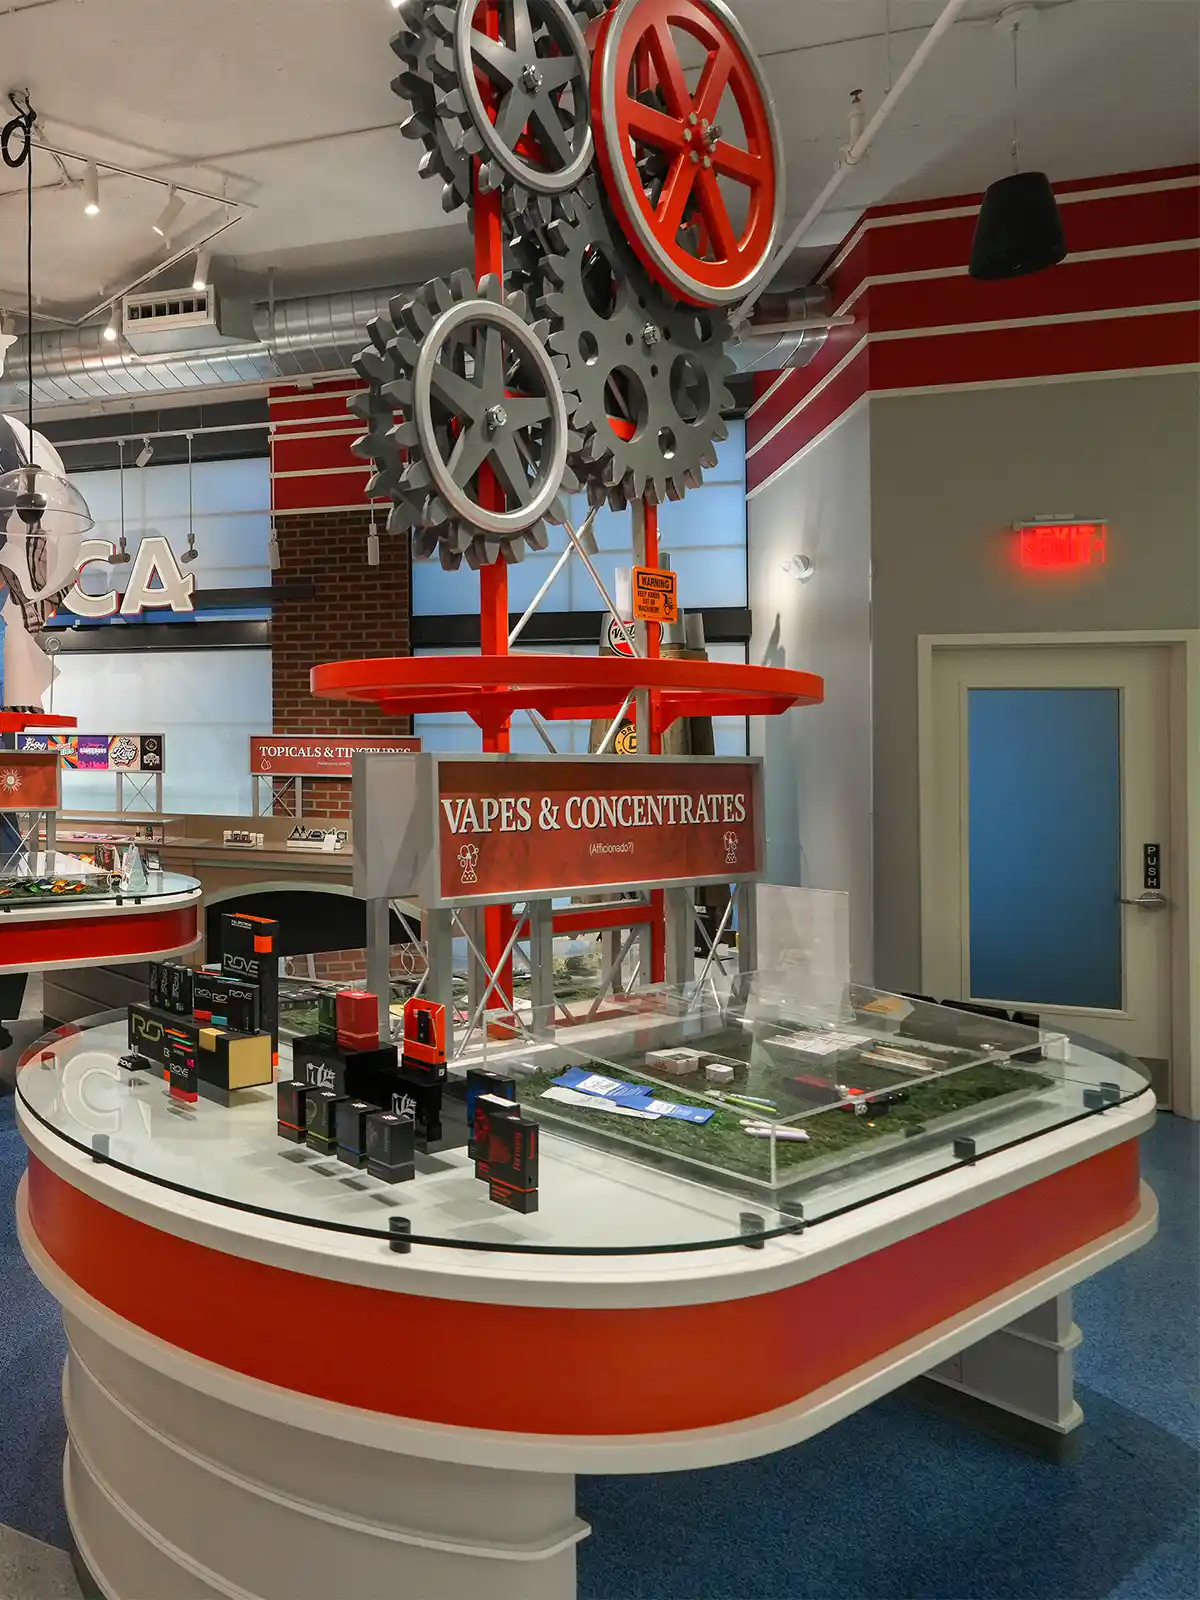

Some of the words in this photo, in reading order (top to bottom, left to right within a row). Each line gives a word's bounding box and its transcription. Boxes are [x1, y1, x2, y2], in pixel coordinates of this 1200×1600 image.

[641, 576, 670, 589] WARNING
[259, 746, 322, 758] TOPICALS
[323, 746, 335, 758] &
[441, 796, 532, 834] VAPES
[538, 797, 561, 831] &
[564, 793, 747, 830] CONCENTRATES
[1147, 846, 1157, 886] PUSH
[223, 953, 260, 976] ROVE
[229, 989, 253, 1000] ROVE
